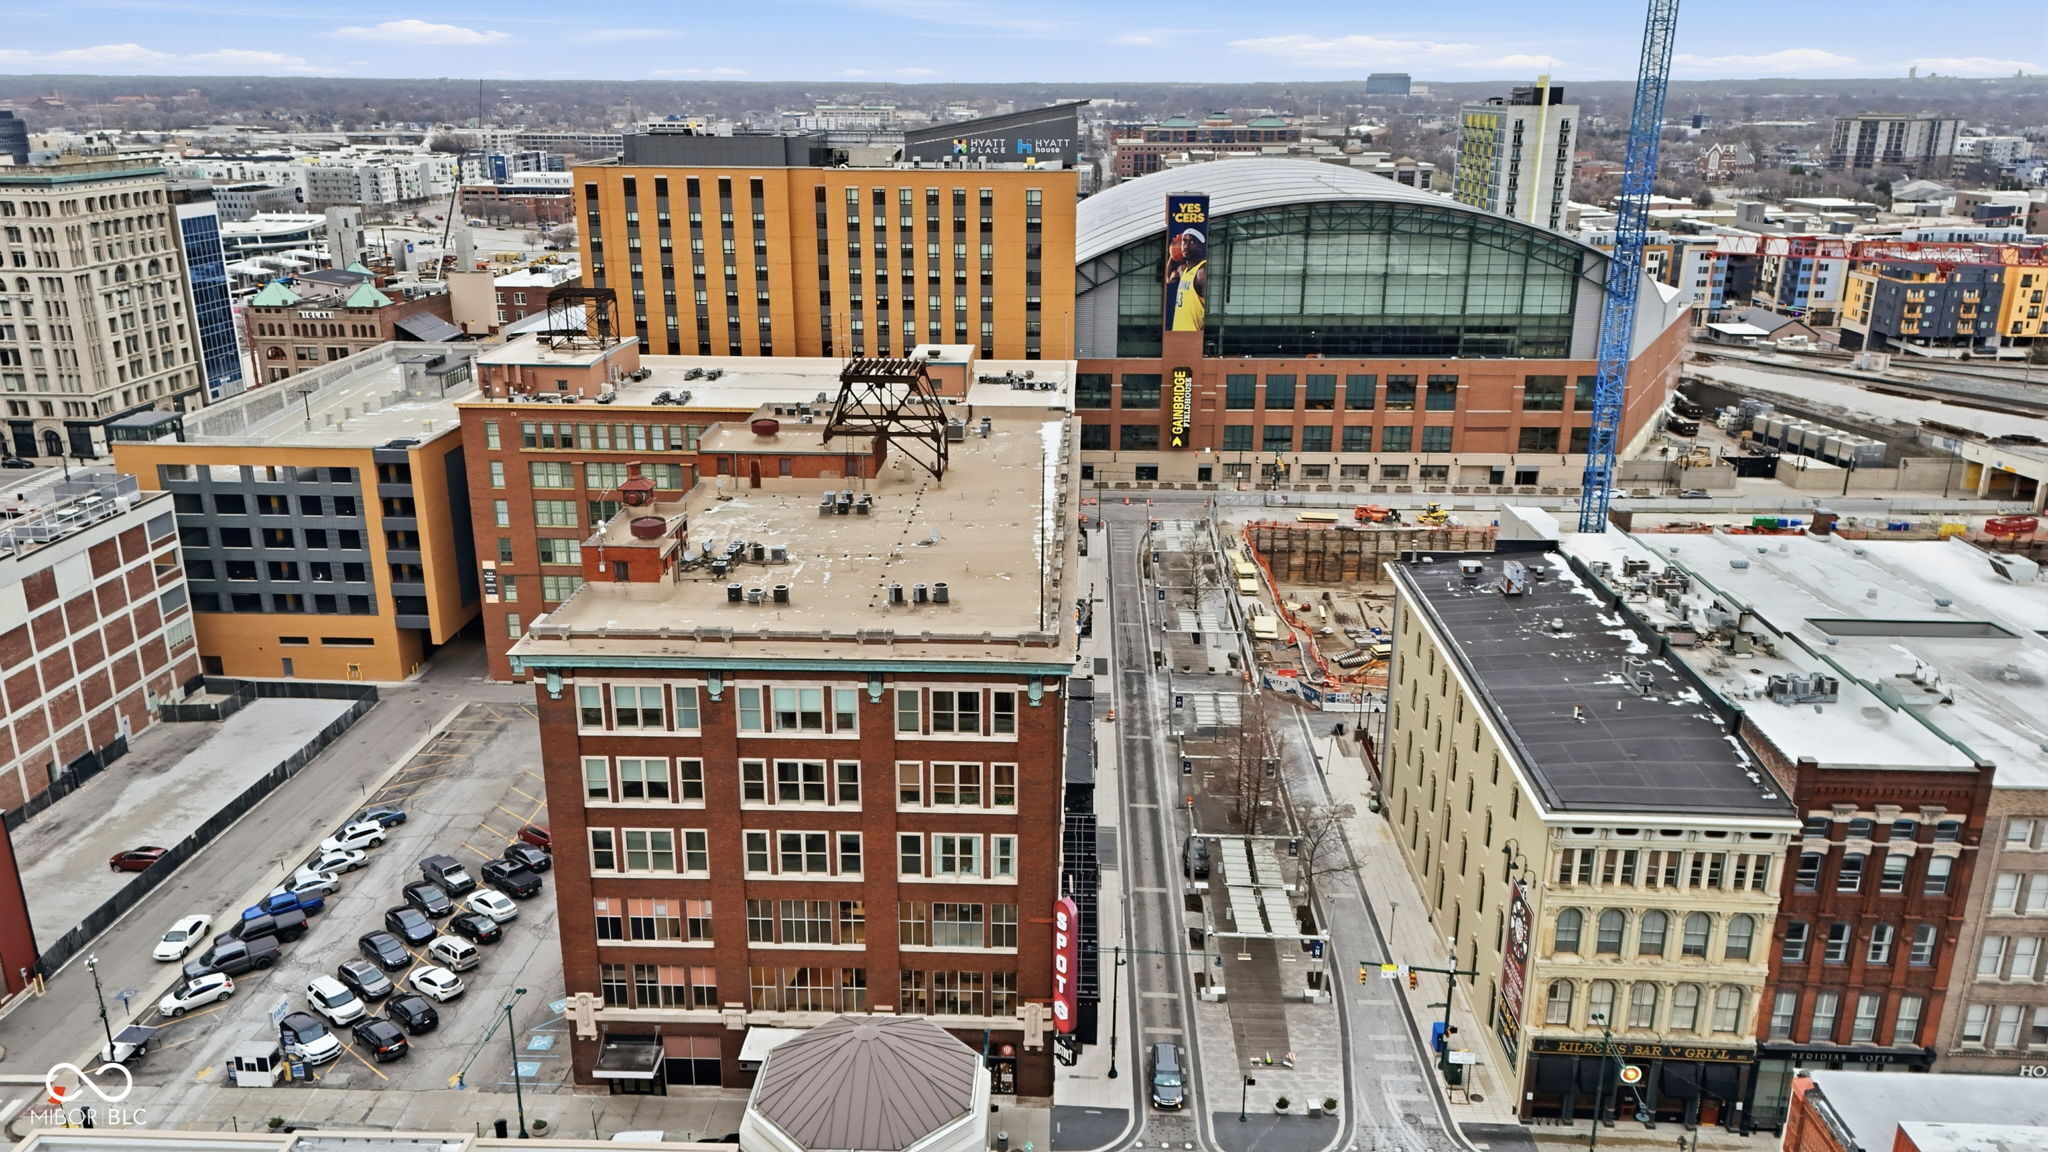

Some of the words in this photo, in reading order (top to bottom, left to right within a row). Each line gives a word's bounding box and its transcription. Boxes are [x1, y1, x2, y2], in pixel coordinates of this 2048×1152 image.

[971, 139, 1006, 147] HYATT
[1036, 139, 1070, 147] HYATT
[1179, 203, 1201, 213] YES
[1172, 213, 1205, 223] 'CERS
[1172, 371, 1186, 434] GAINBRIDGE
[1183, 377, 1192, 428] FIELDHOUSE
[1056, 911, 1067, 994] SPOT
[1632, 1045, 1662, 1056] BAR
[1791, 1052, 1847, 1061] MERIDIAN
[2020, 1065, 2048, 1077] HO
